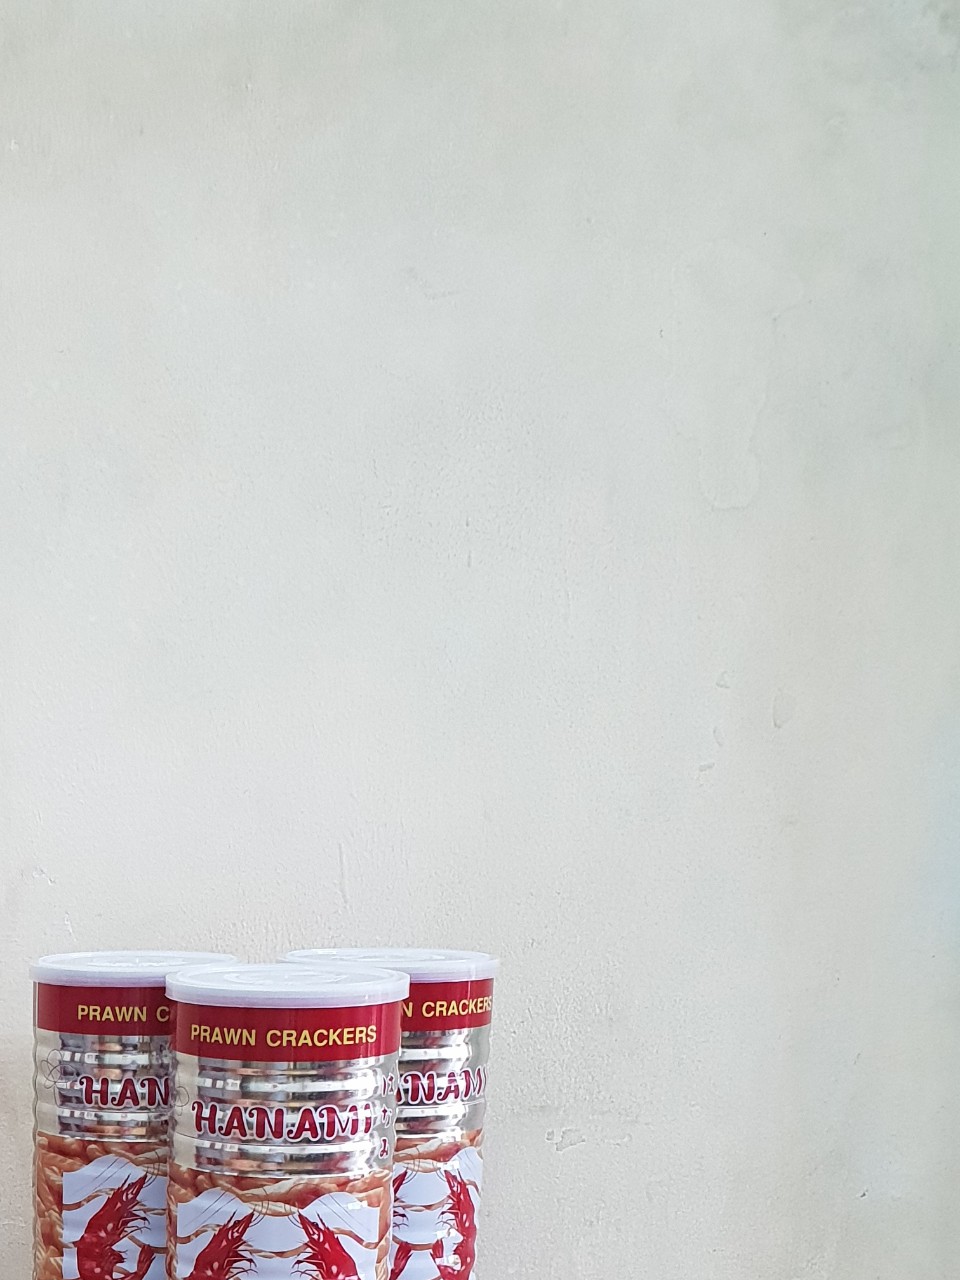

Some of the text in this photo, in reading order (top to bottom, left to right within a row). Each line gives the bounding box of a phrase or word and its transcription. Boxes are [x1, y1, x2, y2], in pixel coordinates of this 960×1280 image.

[77, 1004, 147, 1022] PRAWN
[422, 996, 492, 1018] CRACKERS
[191, 1024, 377, 1047] PRAWN CRACKERS
[79, 1075, 170, 1107] HAN
[191, 1100, 374, 1141] HANAMI
